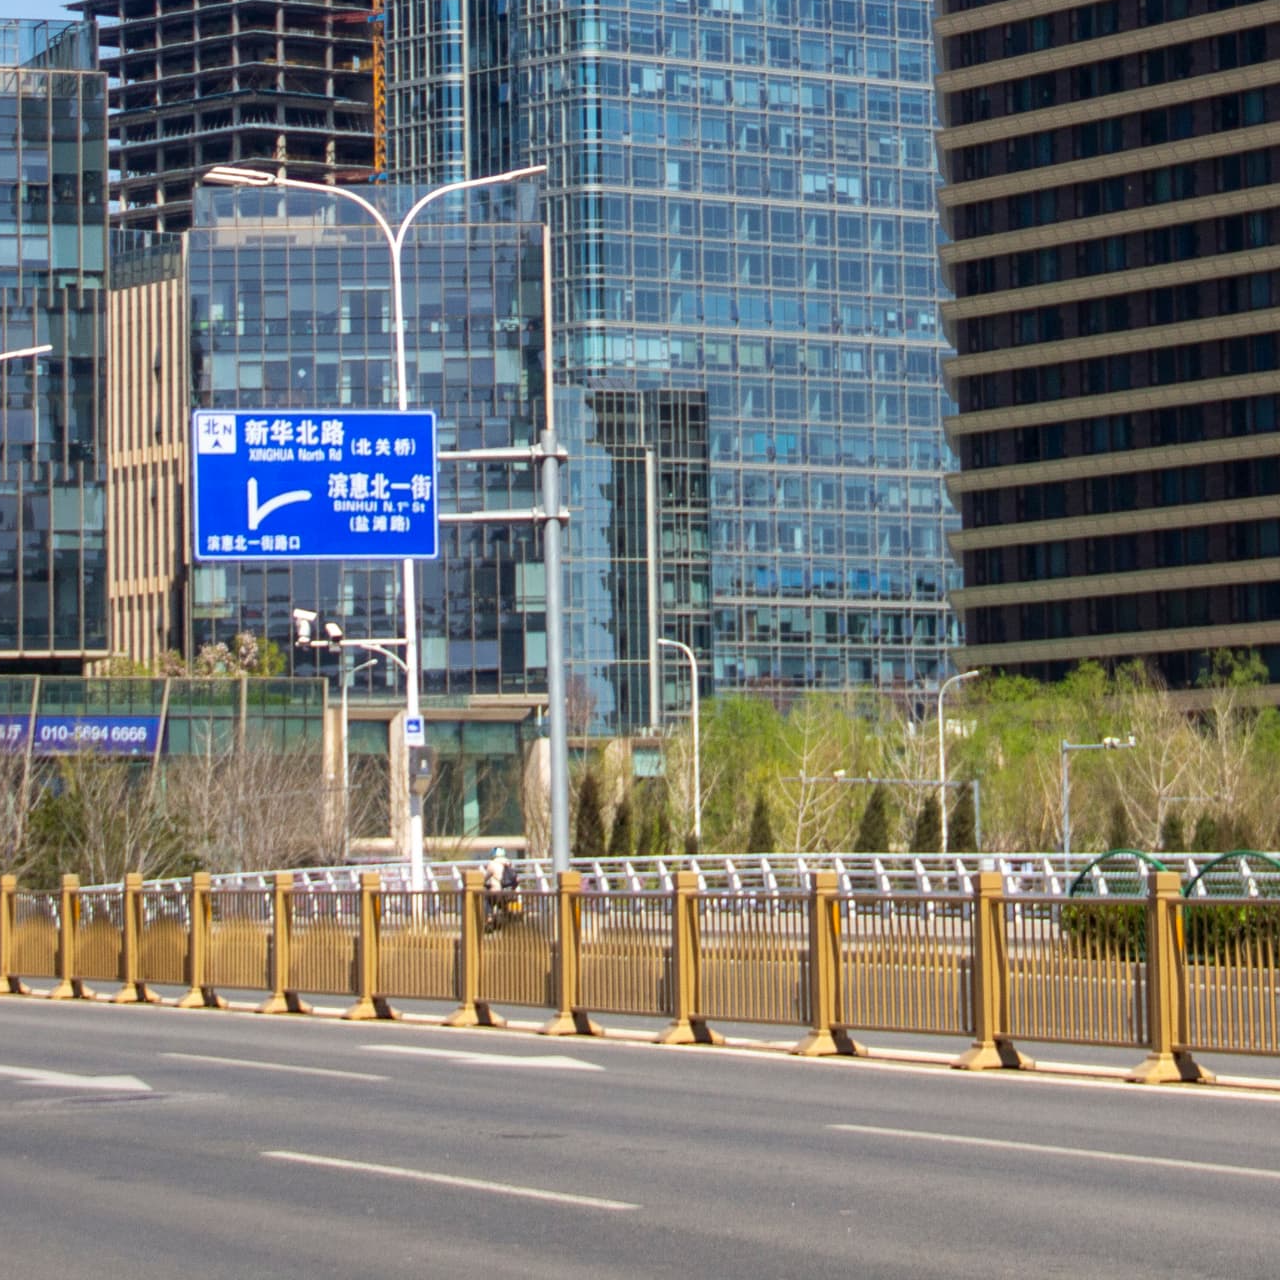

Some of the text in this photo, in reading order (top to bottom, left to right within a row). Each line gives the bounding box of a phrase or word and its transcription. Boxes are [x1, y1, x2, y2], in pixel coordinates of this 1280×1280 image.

[203, 418, 232, 436] 北 N
[245, 419, 344, 446] 新华北路
[328, 472, 432, 501] 滨惠北一街
[333, 500, 377, 512] BINHUI
[207, 534, 300, 552] 滨惠北一街路口
